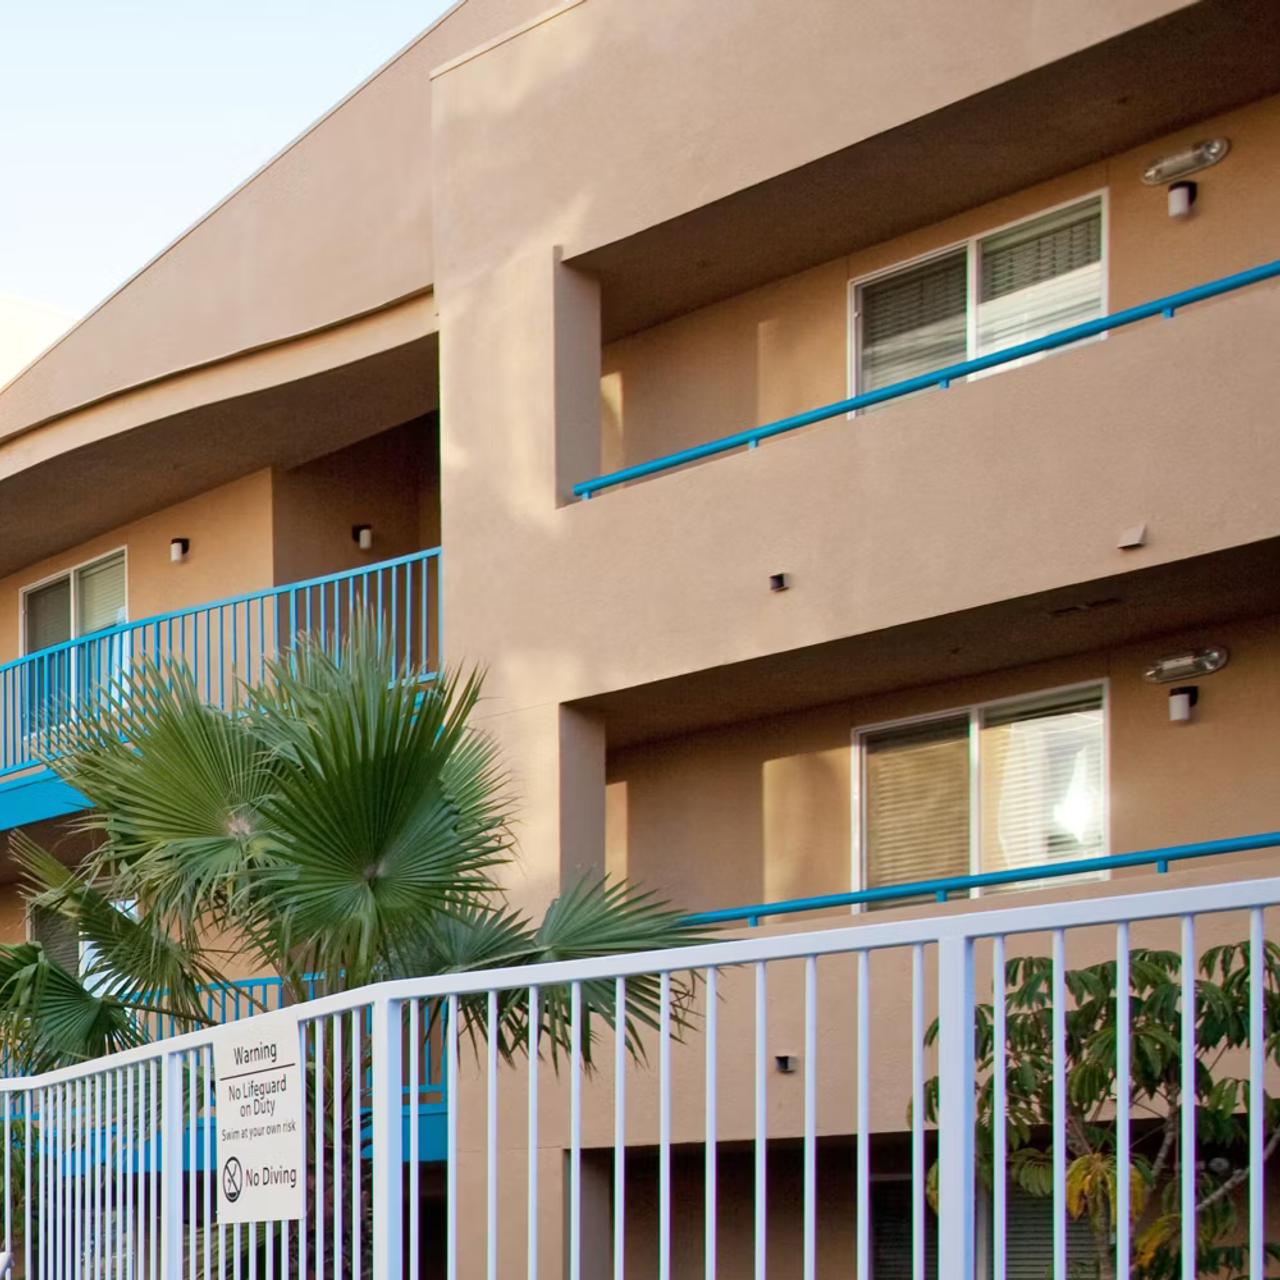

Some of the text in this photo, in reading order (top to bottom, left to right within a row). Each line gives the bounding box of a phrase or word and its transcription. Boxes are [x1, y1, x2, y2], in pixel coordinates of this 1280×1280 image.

[233, 1042, 277, 1065] Warning
[228, 1073, 287, 1101] No Lifeguard
[240, 1098, 275, 1117] on Duty
[221, 1119, 297, 1142] Swim at your own risk
[245, 1165, 297, 1189] No Diving
